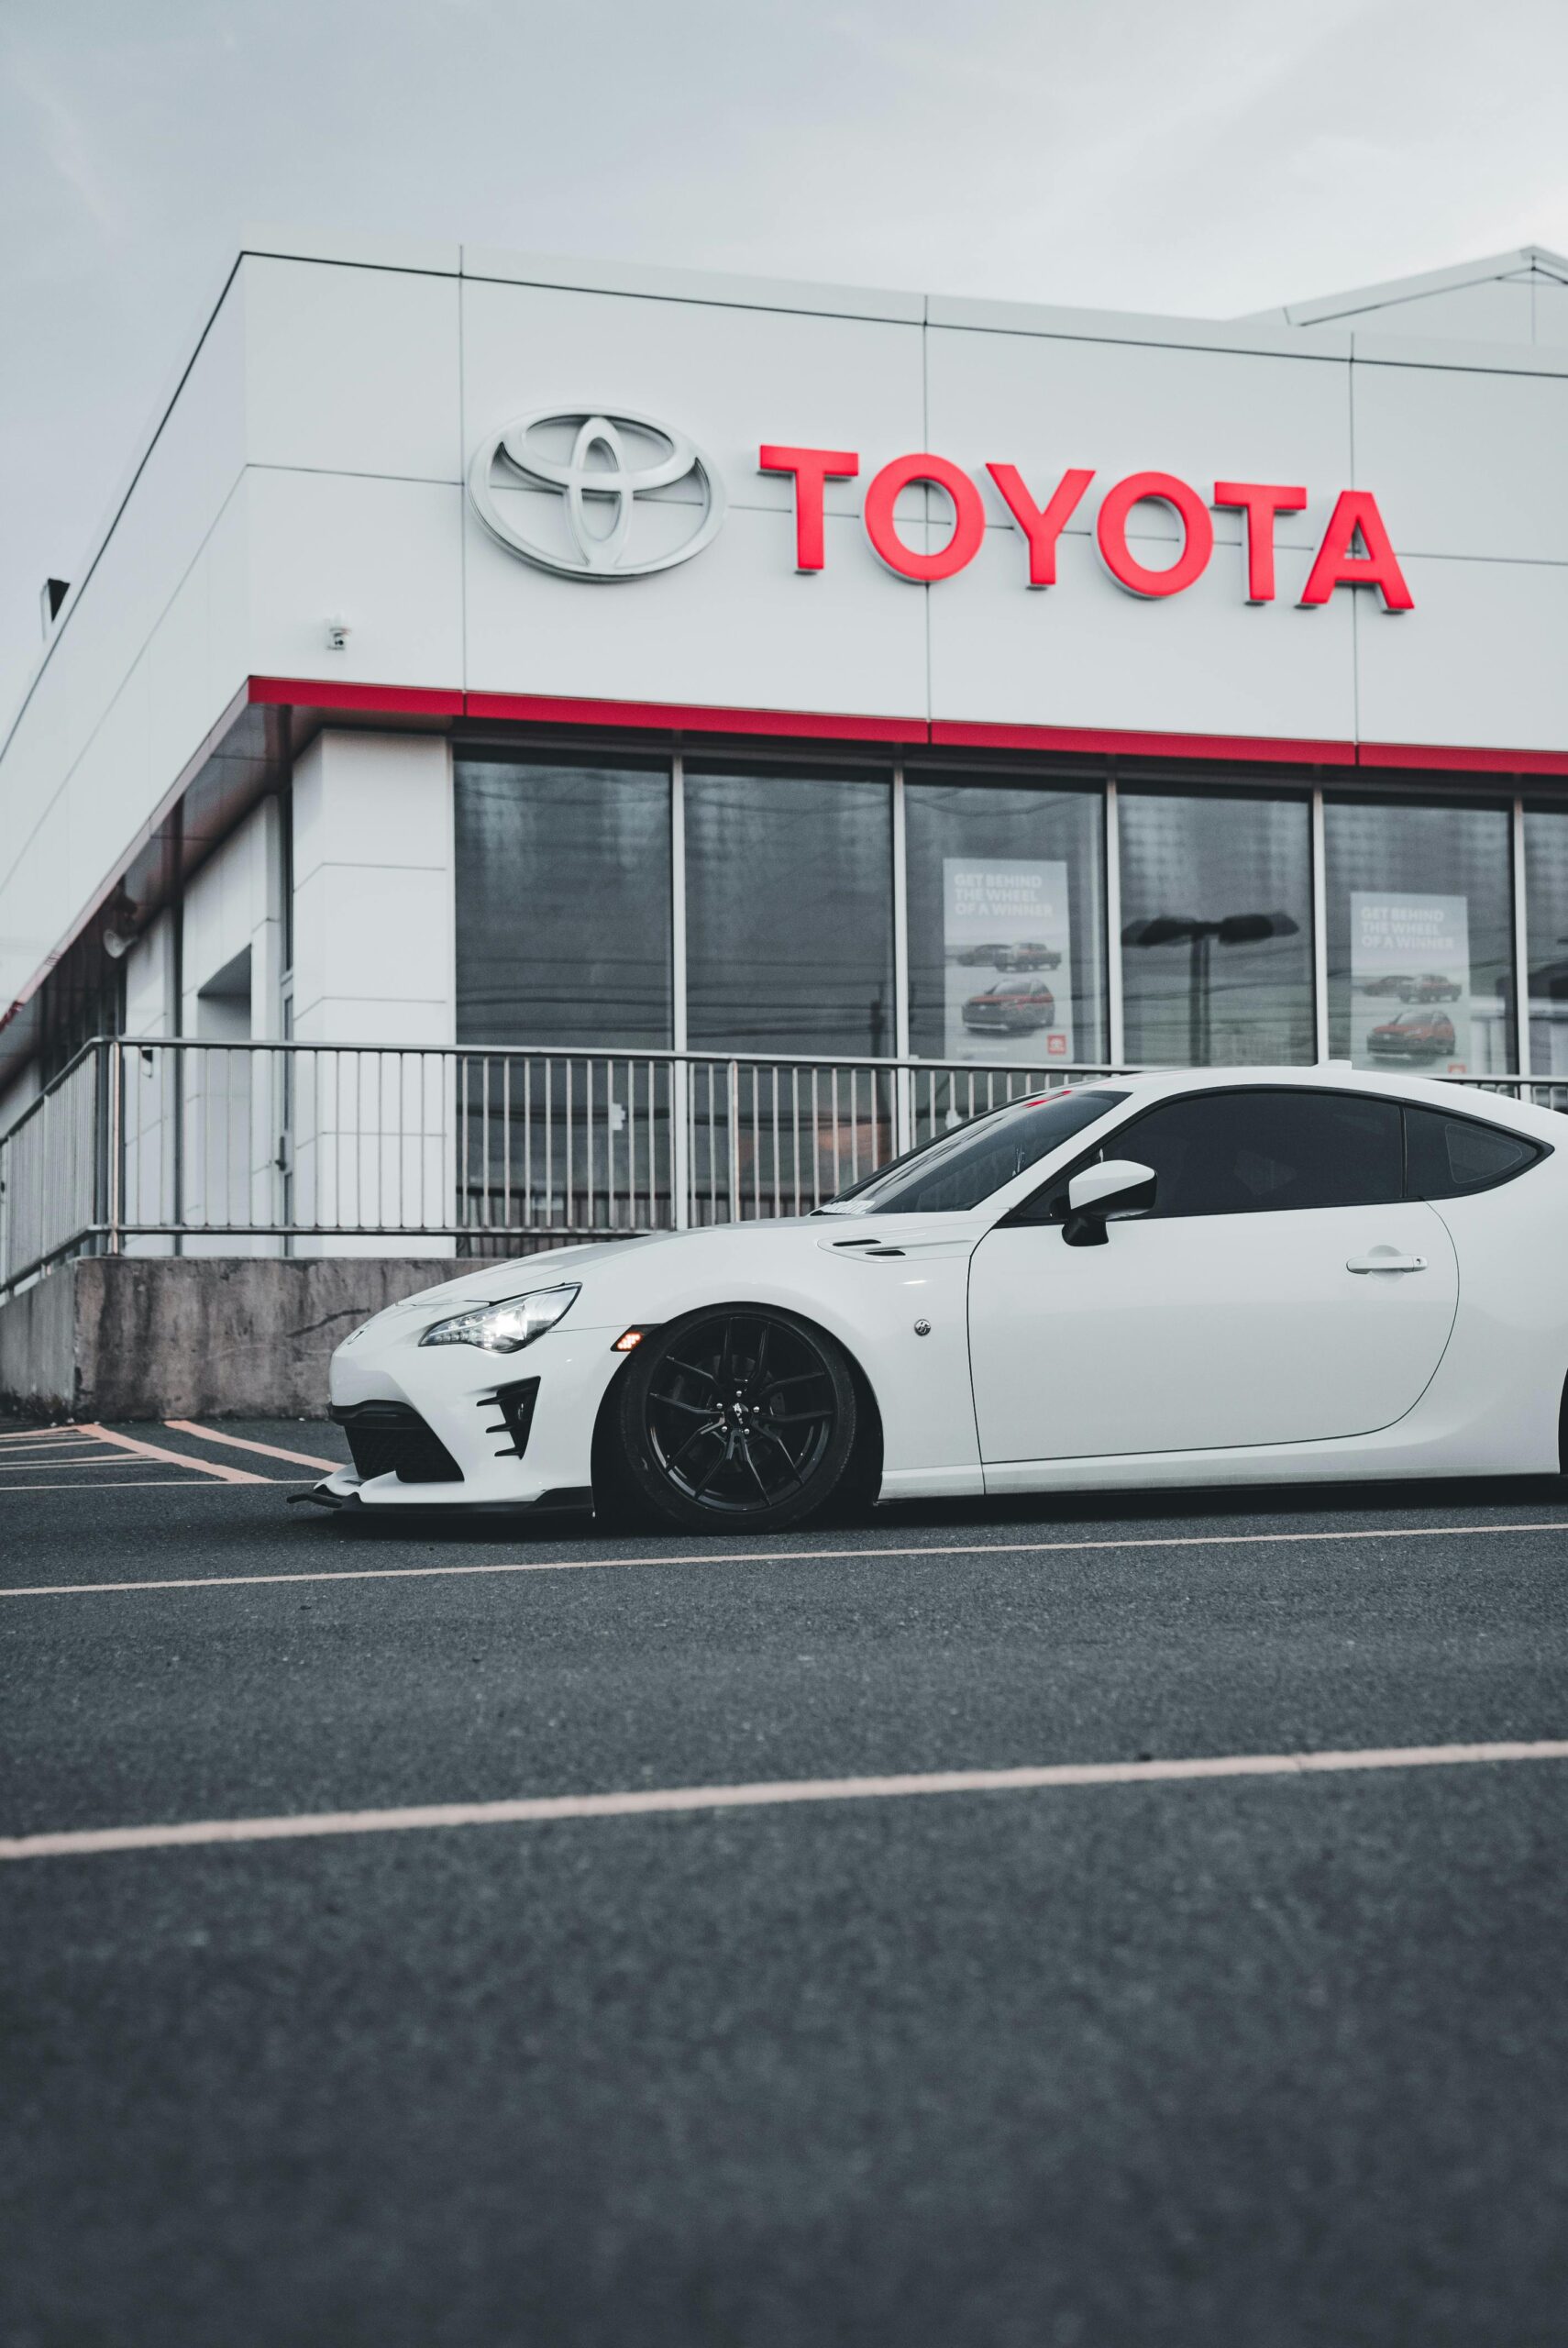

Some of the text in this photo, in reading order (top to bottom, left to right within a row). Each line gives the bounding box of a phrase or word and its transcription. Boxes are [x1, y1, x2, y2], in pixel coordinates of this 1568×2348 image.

[759, 445, 1414, 609] TOYOTA
[954, 873, 1043, 888] GET BEHIND
[955, 888, 1038, 902] THE WHEEL
[955, 903, 1053, 917] OF A WINNER
[1361, 906, 1444, 922] GET BEHIND
[1361, 920, 1441, 935] THE WHEEL
[1361, 935, 1381, 947] OF
